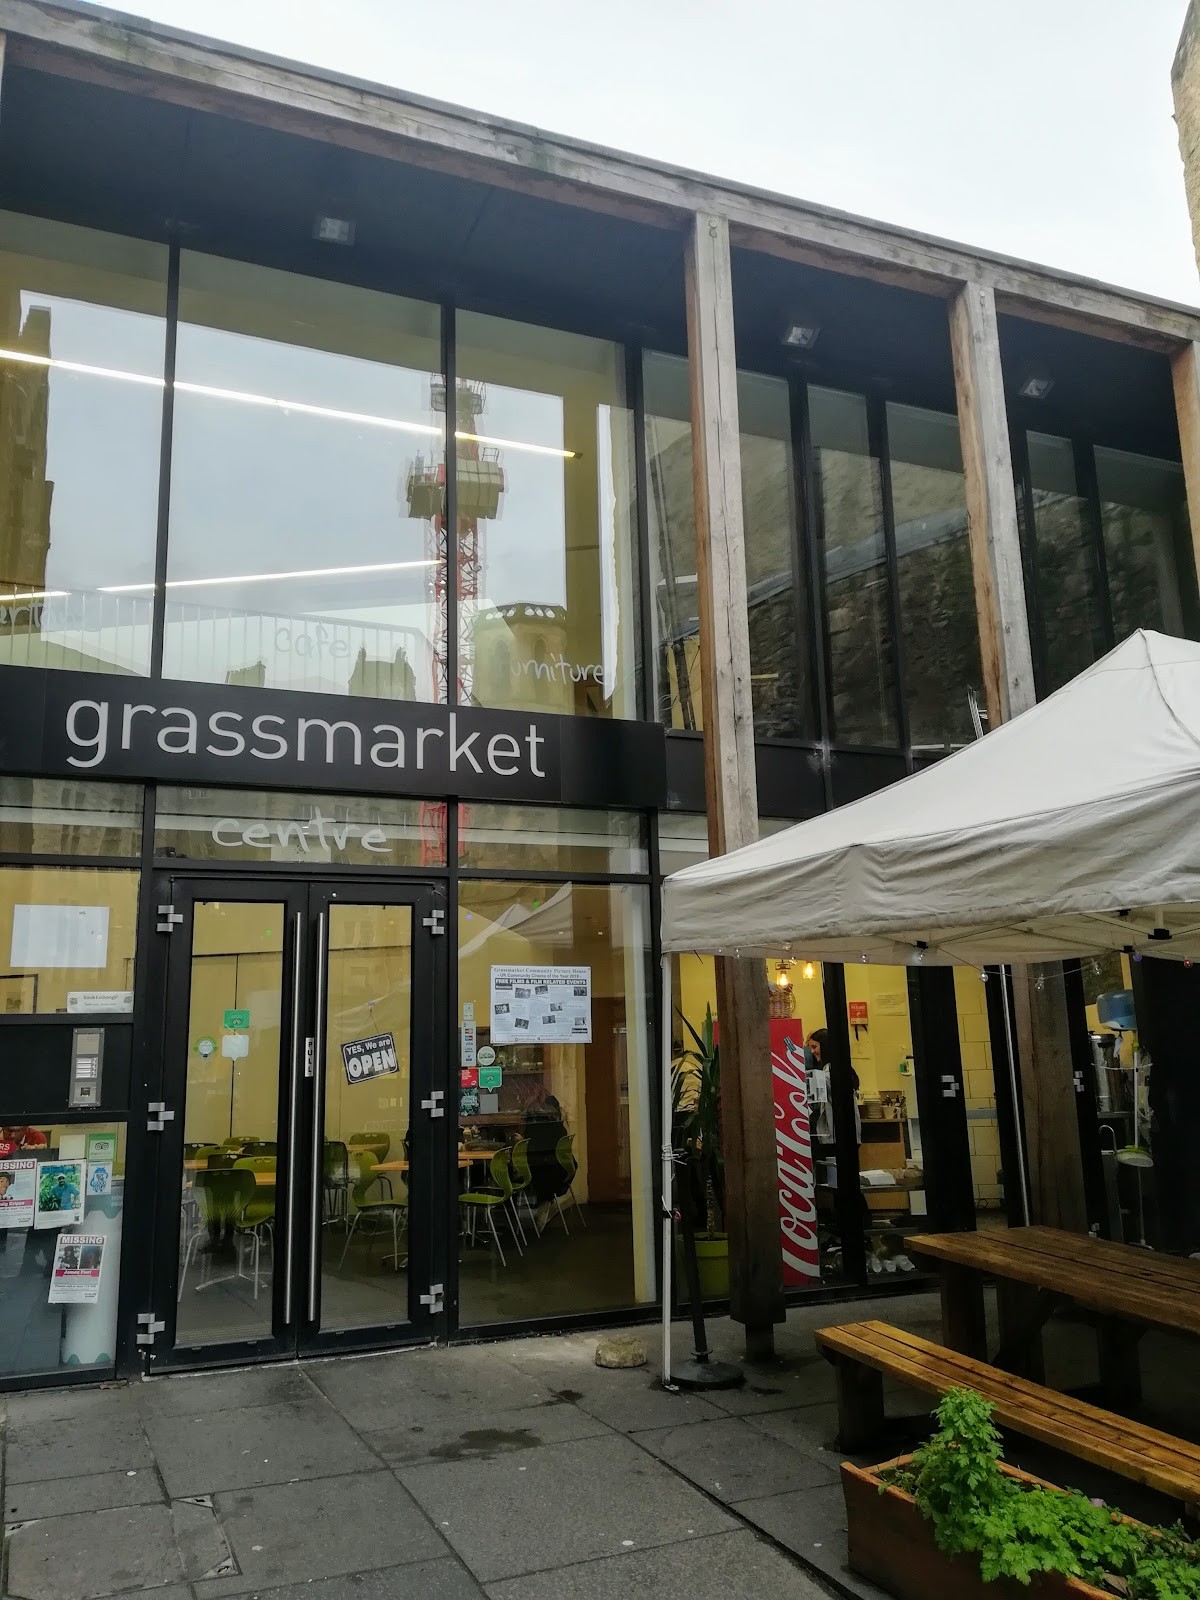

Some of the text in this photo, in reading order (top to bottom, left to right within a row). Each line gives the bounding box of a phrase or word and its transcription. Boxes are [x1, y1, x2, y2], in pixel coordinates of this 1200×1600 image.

[510, 652, 604, 685] urniture
[65, 699, 545, 778] grassmarket
[211, 805, 393, 853] centre
[346, 1038, 391, 1055] YES, We are
[348, 1048, 396, 1078] OPEN
[61, 1236, 104, 1244] MISSING
